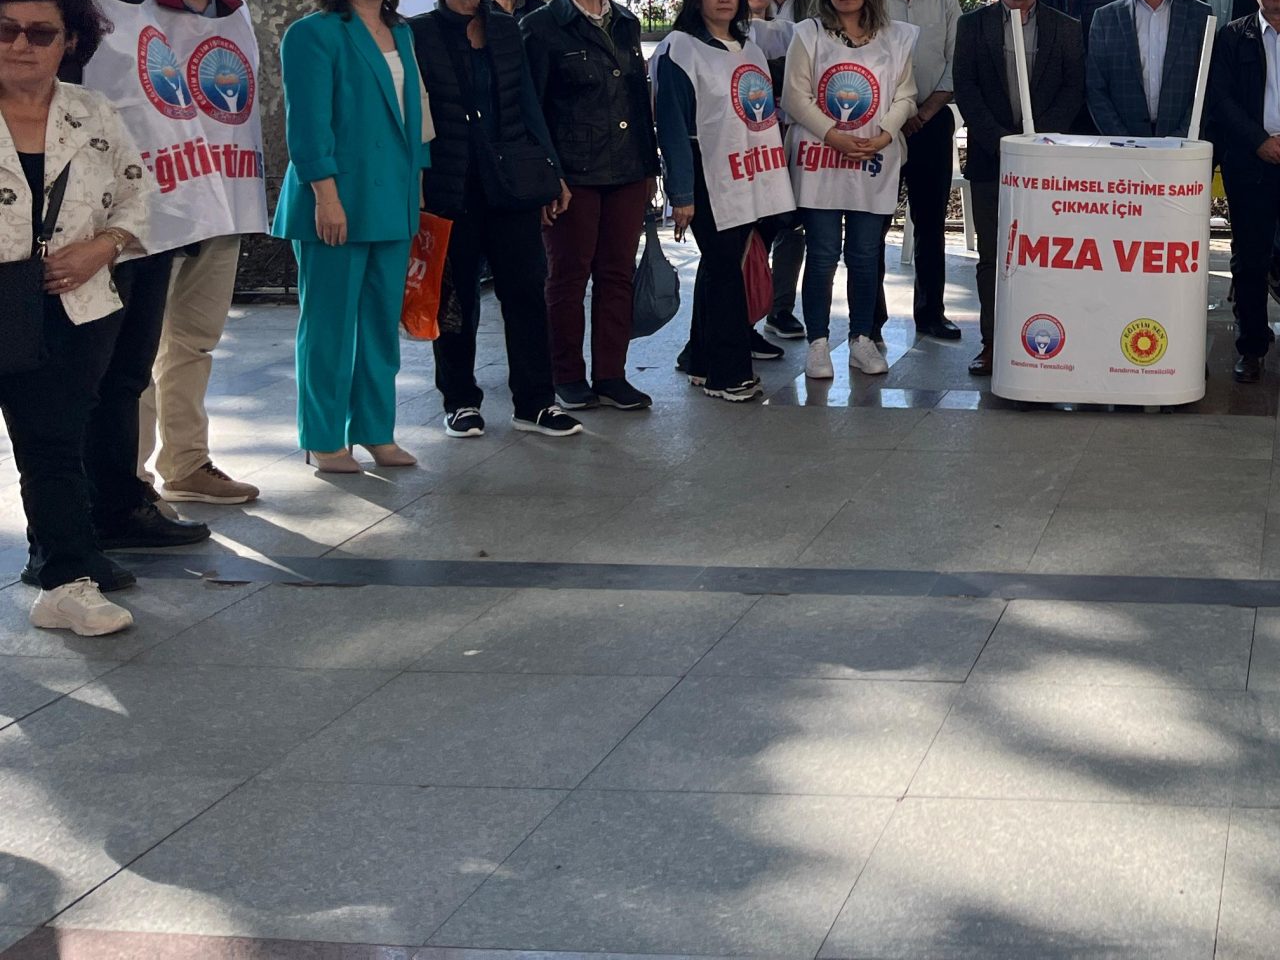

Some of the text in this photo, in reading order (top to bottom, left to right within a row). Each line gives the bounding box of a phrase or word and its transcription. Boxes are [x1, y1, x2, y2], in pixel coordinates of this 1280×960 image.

[1001, 172, 1204, 197] LAİK VE BİLİMSEL EĞİTİME SAHİP
[1051, 200, 1143, 219] ÇIKMAK İÇİN
[1113, 240, 1201, 273] VER!
